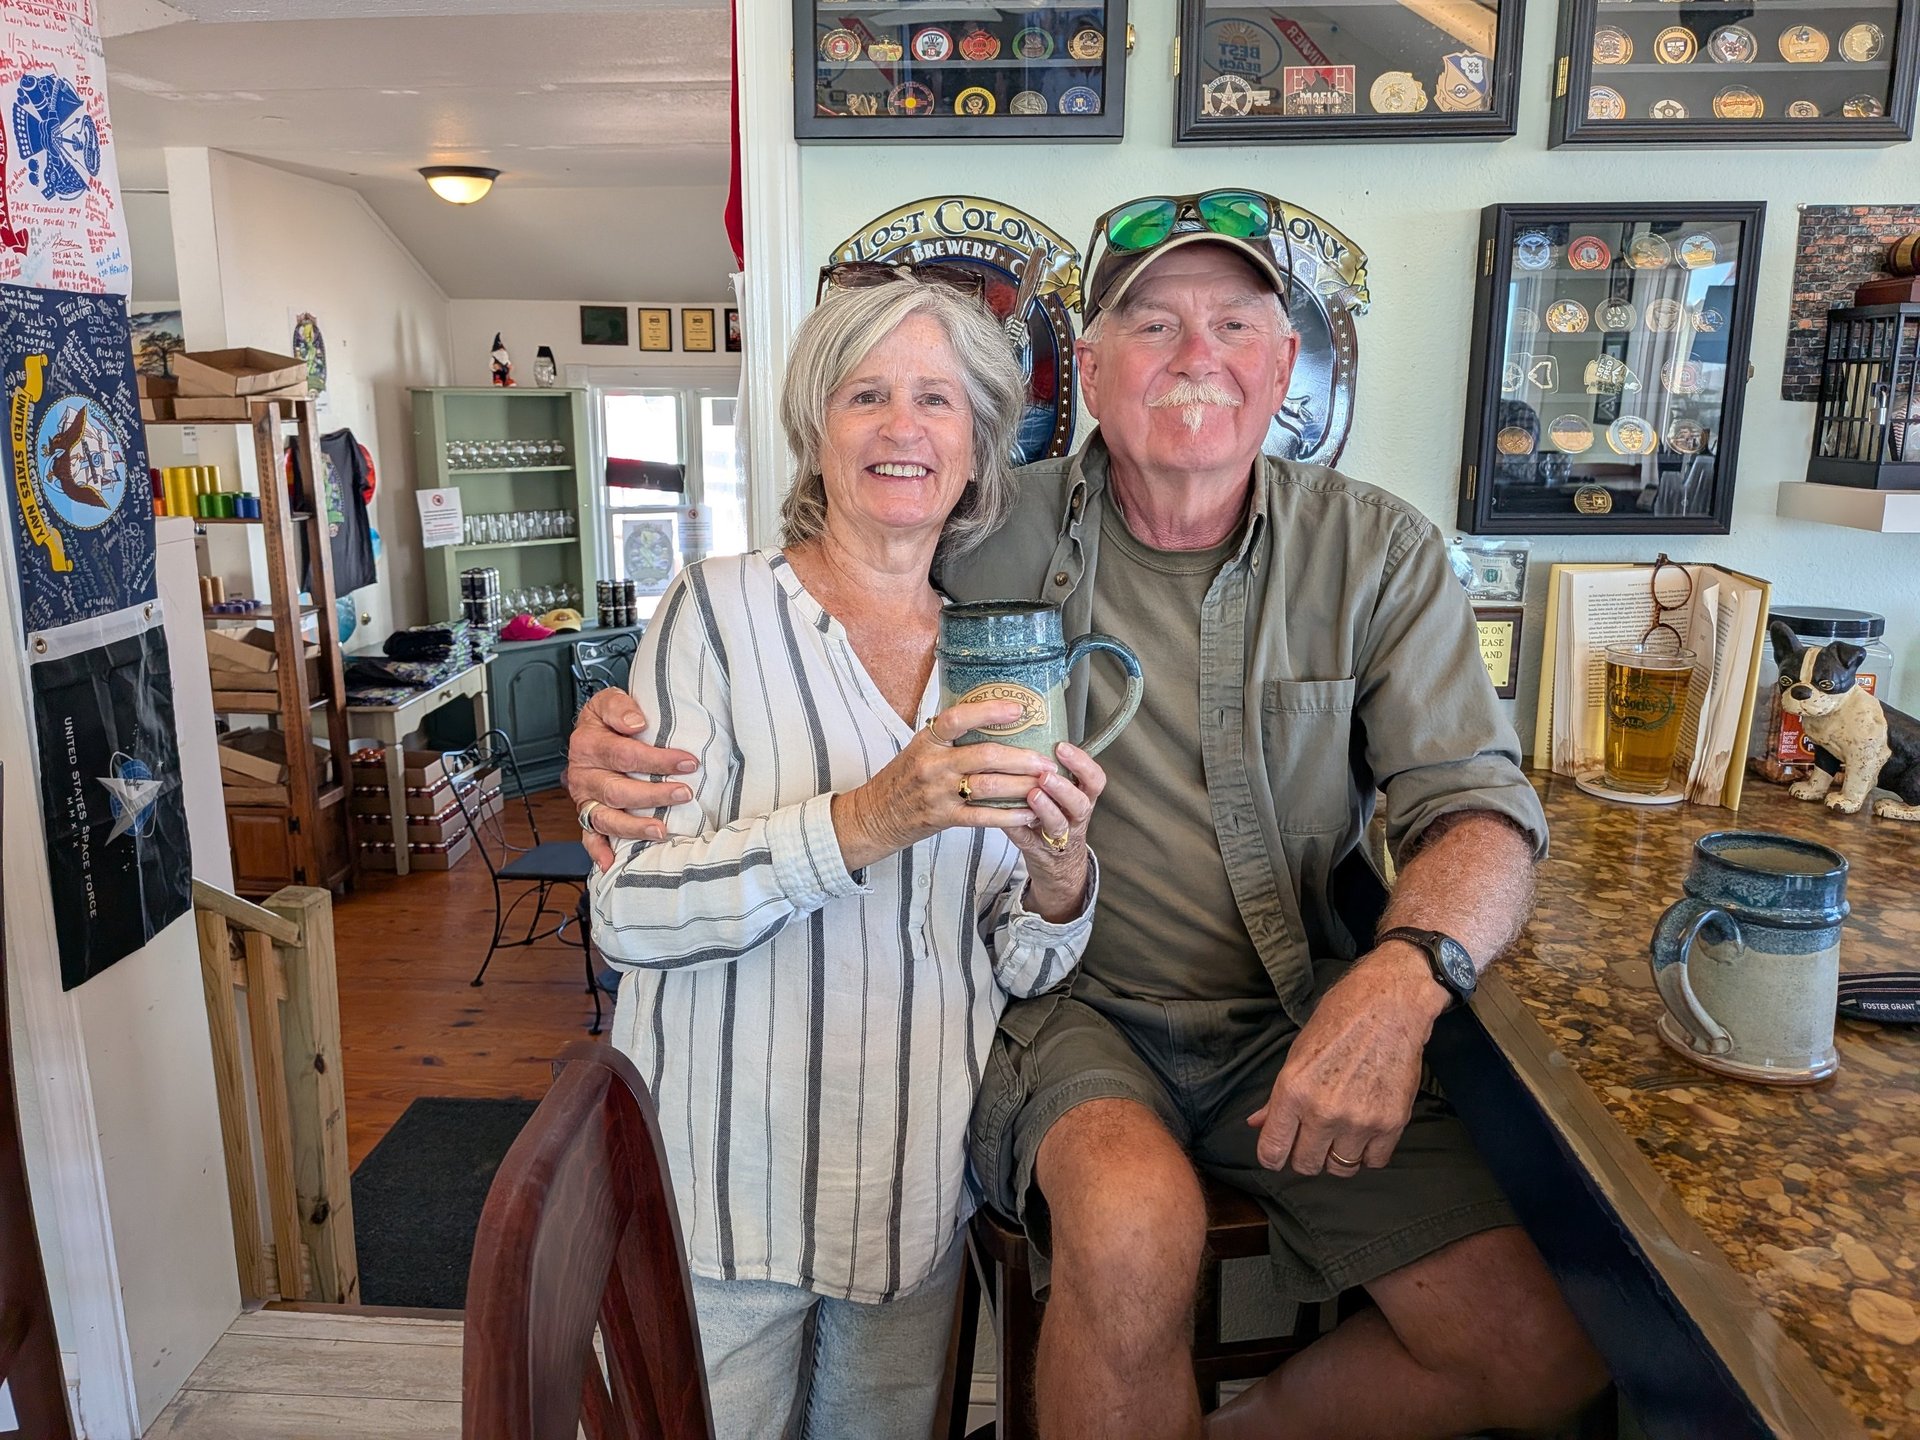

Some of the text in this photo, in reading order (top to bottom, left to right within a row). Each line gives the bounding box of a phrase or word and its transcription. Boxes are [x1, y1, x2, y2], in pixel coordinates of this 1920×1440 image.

[849, 200, 1062, 265] LOST COLONY
[912, 239, 998, 262] BREWERY
[24, 325, 52, 338] JONES
[16, 335, 56, 350] MUSTANG
[13, 394, 46, 539] UNITED STATES NAVY
[1491, 626, 1504, 635] ON
[1480, 639, 1505, 647] EASE
[1484, 651, 1503, 659] AND
[991, 687, 1036, 706] COLONY
[1624, 718, 1643, 726] ALE
[64, 716, 98, 919] UNITED STATES SPACE FORCE
[66, 796, 79, 849] MMXIX
[1862, 1002, 1890, 1010] FOSTER
